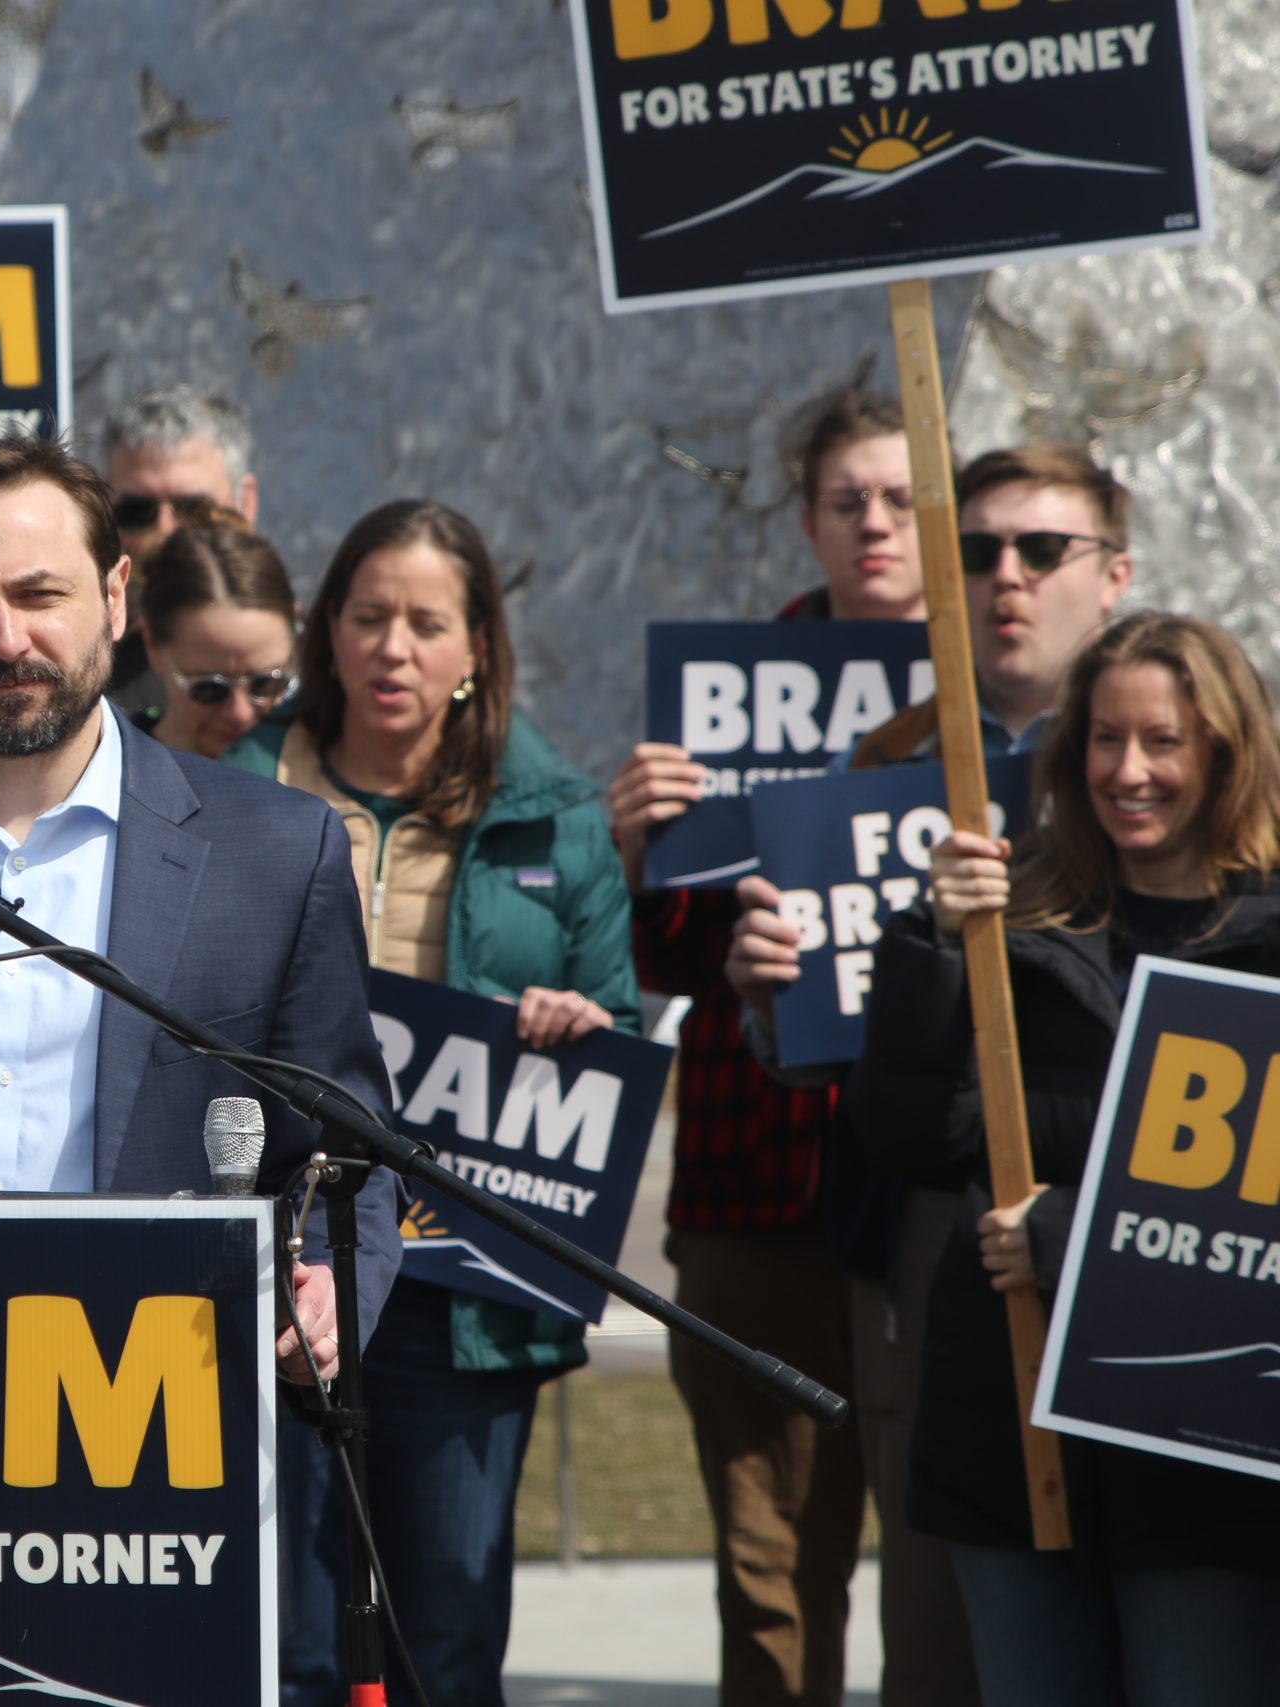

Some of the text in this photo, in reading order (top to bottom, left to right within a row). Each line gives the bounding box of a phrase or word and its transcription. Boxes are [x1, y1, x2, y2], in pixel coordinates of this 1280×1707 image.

[621, 85, 710, 132] FOR
[719, 58, 897, 119] STATE'S
[908, 23, 1155, 95] ATTORNEY
[680, 660, 935, 754] BRA
[851, 801, 1006, 877] FO
[1110, 1210, 1201, 1266] FOR
